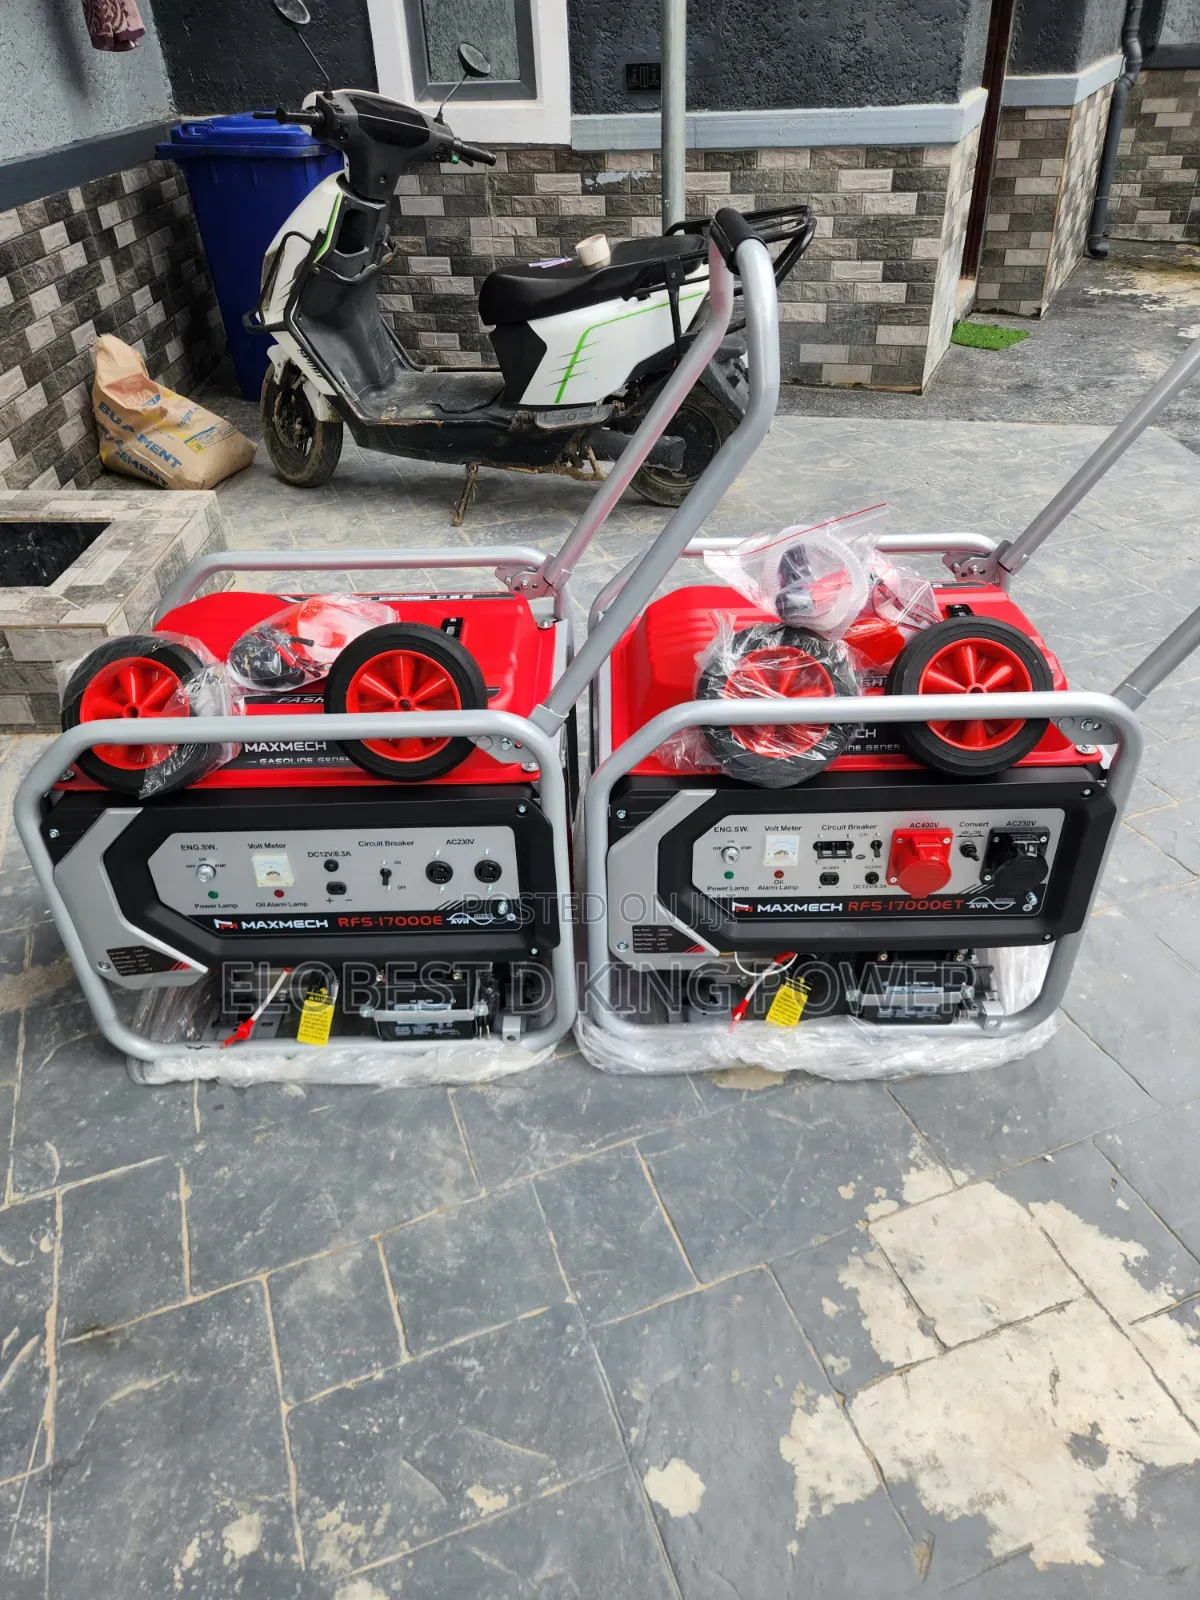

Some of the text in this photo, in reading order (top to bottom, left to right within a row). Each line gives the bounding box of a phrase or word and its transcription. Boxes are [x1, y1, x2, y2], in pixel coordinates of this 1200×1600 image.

[136, 433, 182, 469] MENT
[116, 449, 169, 487] EMENT
[244, 741, 327, 752] MAXMECH
[259, 757, 314, 765] GASOLINE
[847, 823, 878, 831] Breaker
[446, 838, 475, 846] AC230V
[757, 899, 965, 912] MAXMECH RFS-17000ET
[241, 915, 443, 929] MAXMECH RFS-17000E
